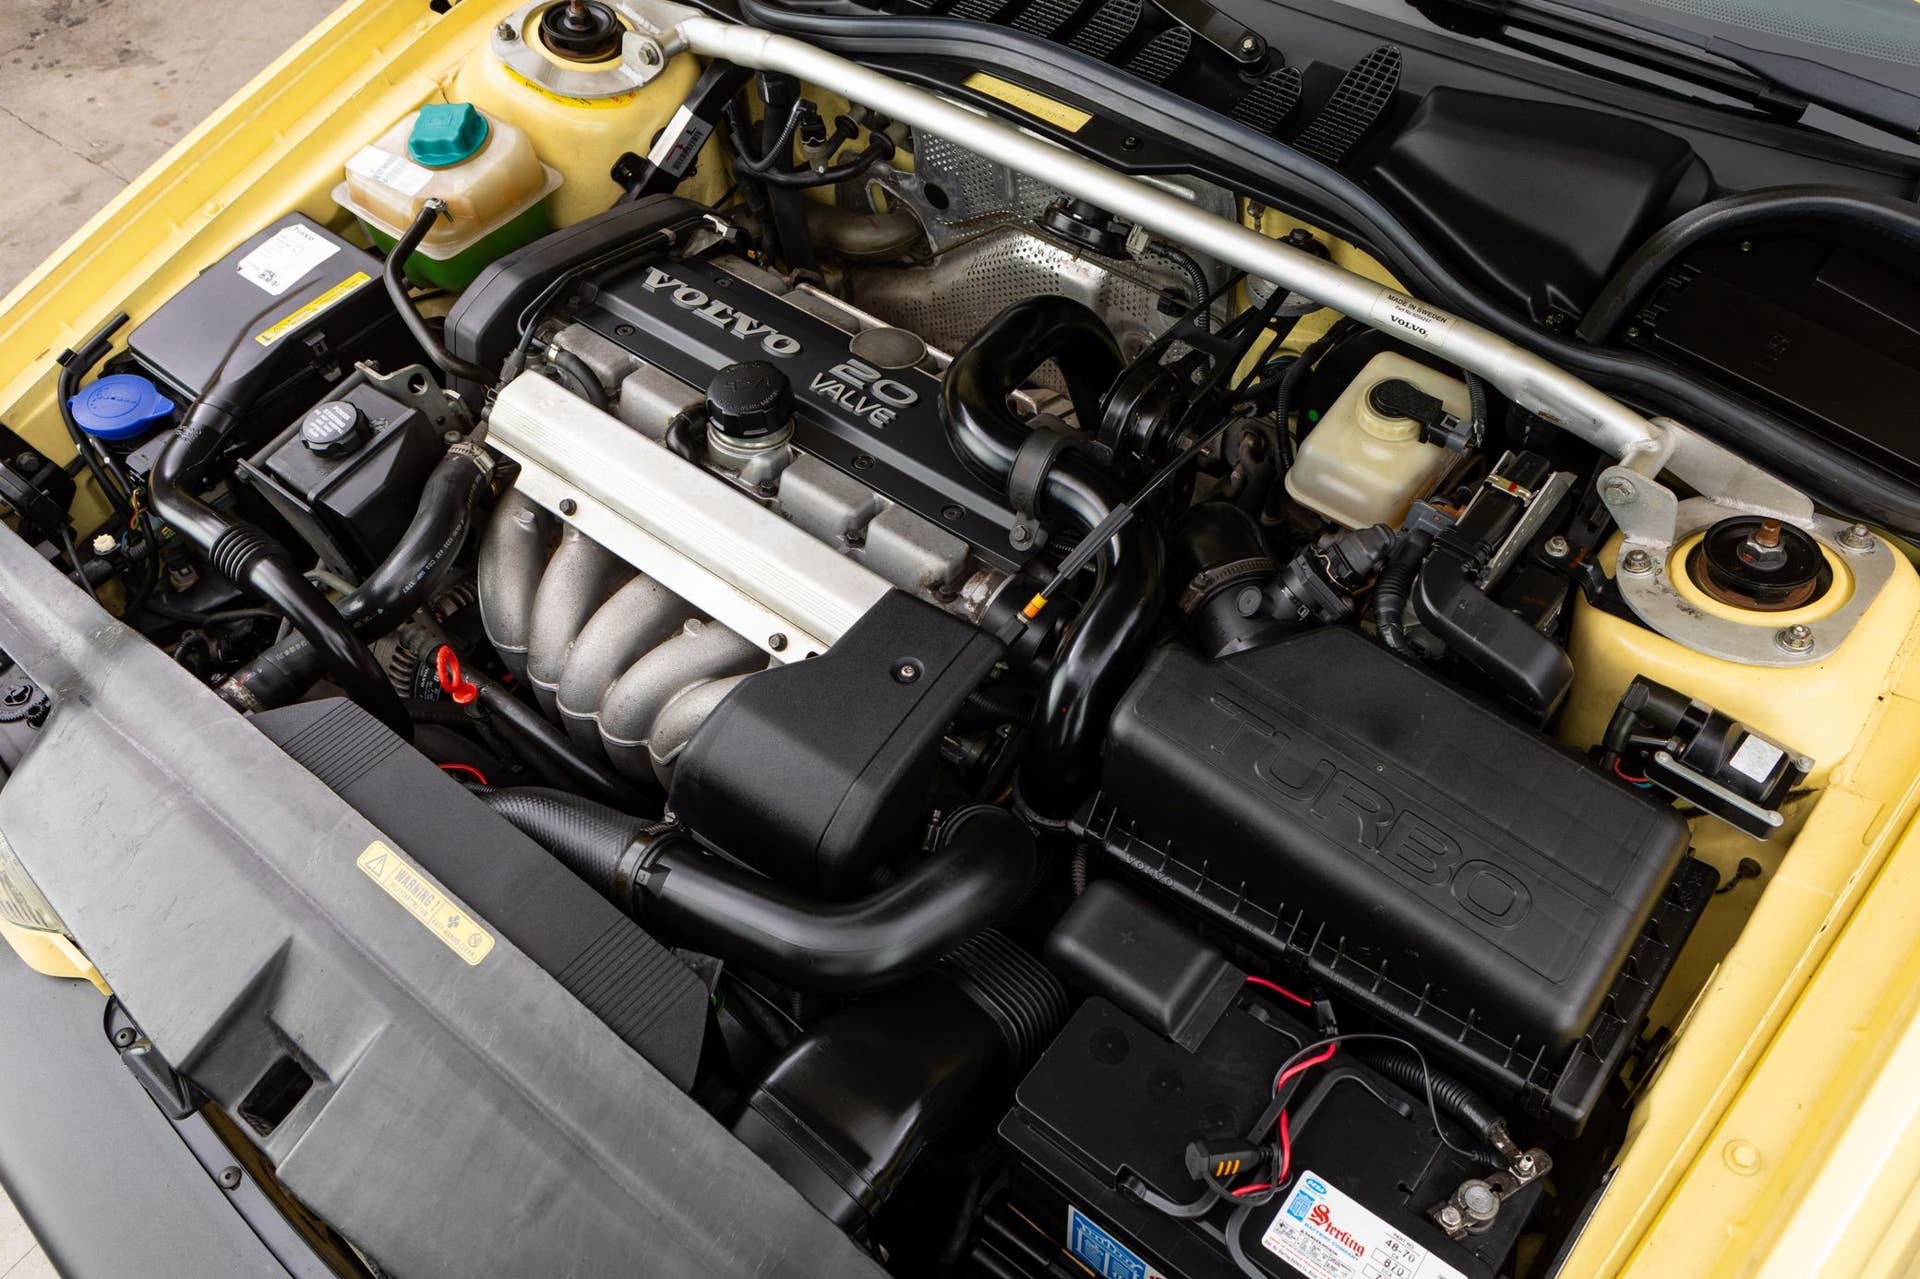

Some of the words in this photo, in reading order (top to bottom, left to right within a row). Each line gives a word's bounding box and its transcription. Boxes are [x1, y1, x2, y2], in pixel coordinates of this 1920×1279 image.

[641, 266, 801, 358] VOLVO
[1388, 294, 1407, 307] MADE
[1418, 307, 1448, 324] SWEDEN
[1391, 314, 1426, 335] VOLVO
[809, 371, 898, 430] VALVE
[828, 358, 918, 408] 20
[333, 406, 351, 421] POWER
[1211, 692, 1532, 930] TURBO
[396, 868, 435, 907] WARNING
[1306, 1204, 1365, 1257] Sterling
[1383, 1258, 1405, 1277] 870
[1385, 1239, 1416, 1263] 48-70
